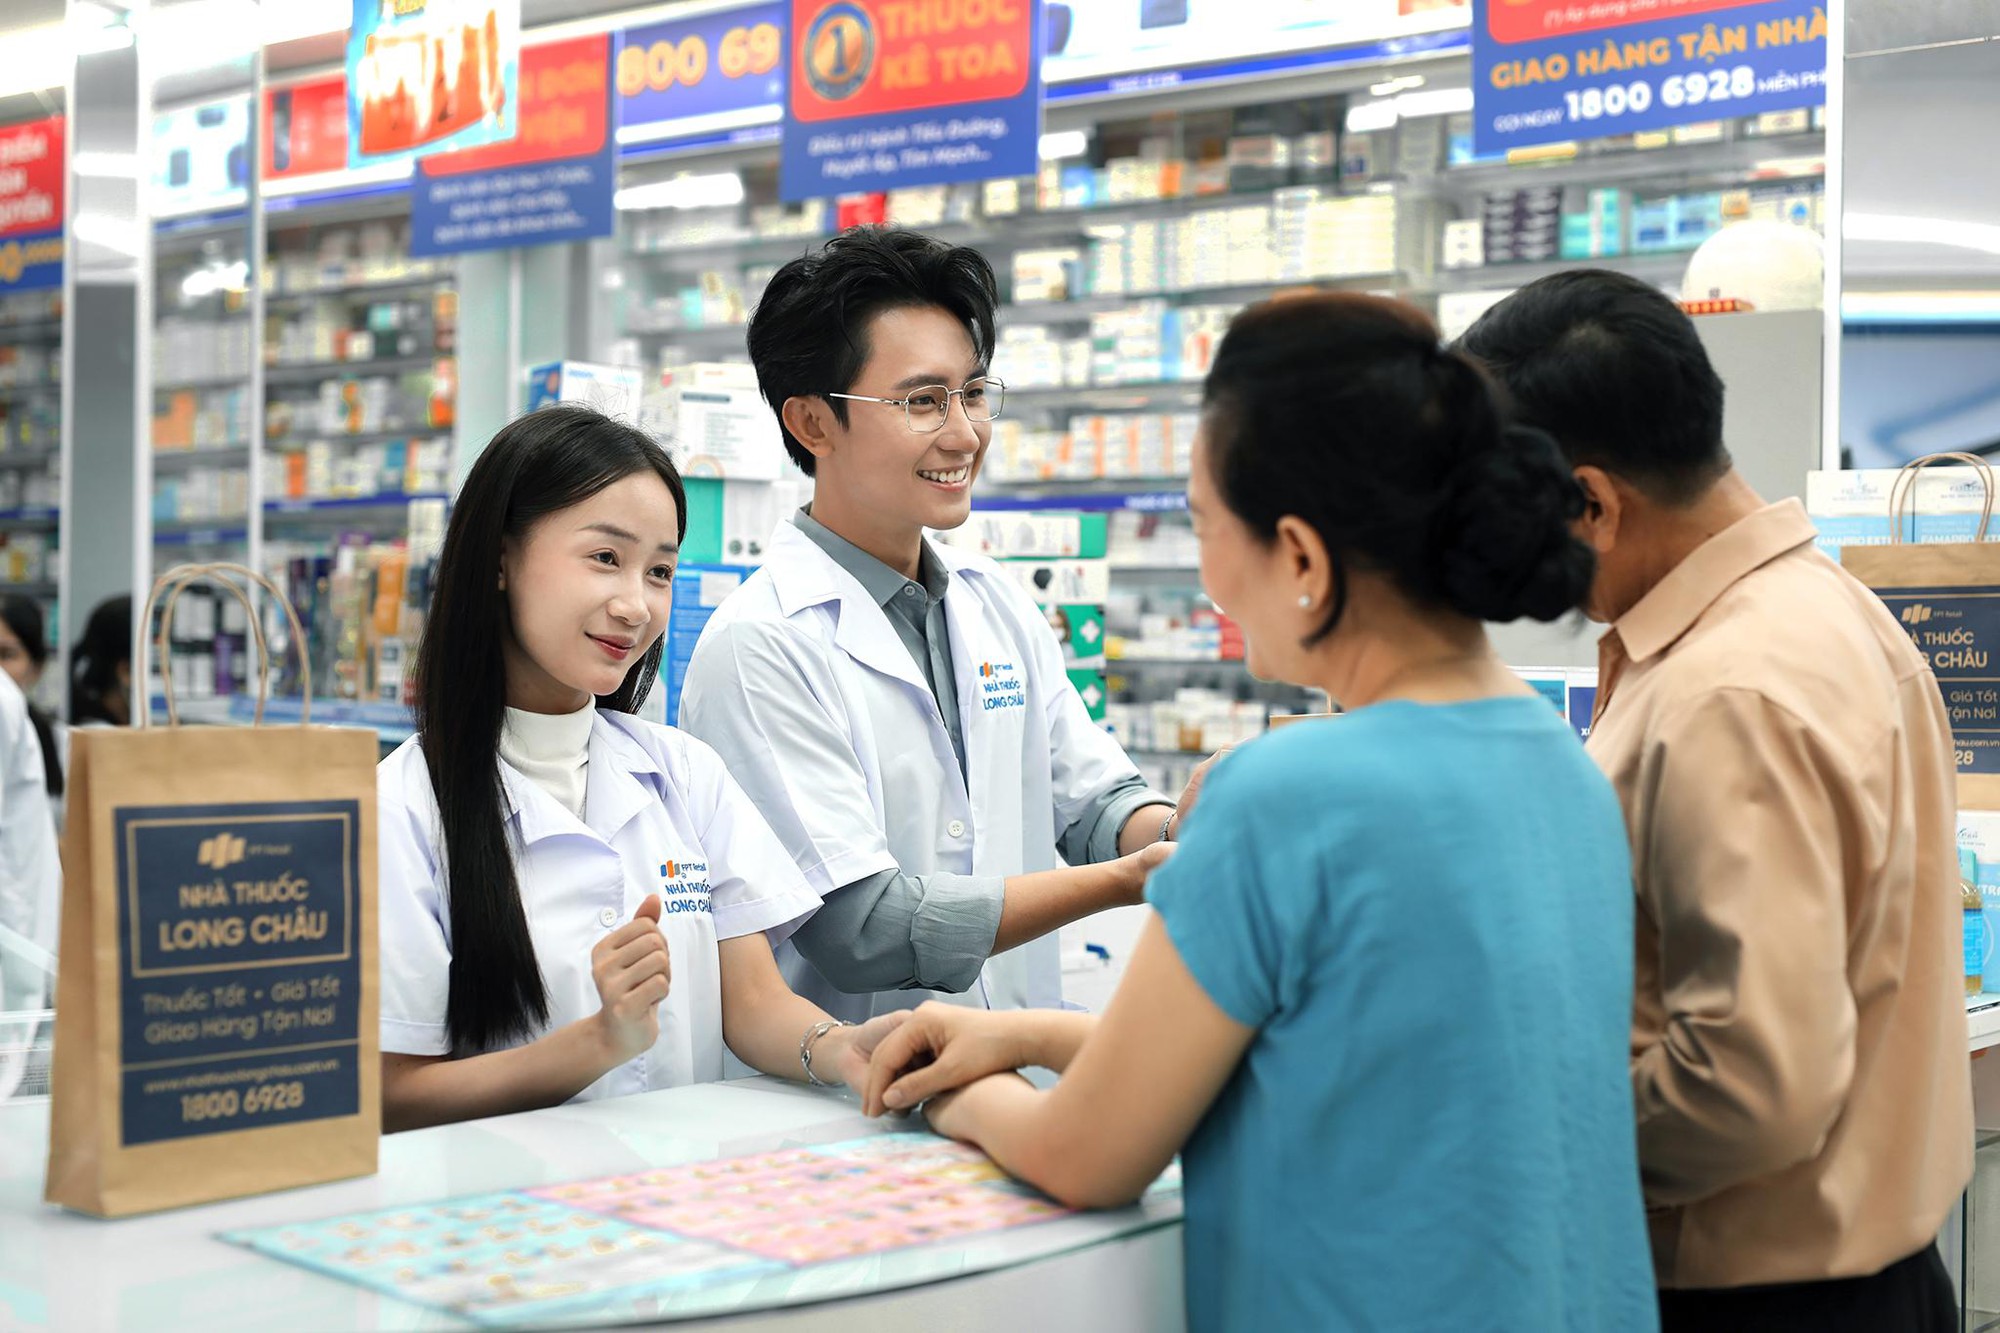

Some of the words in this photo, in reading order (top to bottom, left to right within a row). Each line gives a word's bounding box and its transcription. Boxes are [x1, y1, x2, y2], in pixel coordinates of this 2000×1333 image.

[616, 33, 708, 97] 800
[718, 22, 782, 79] 69
[936, 39, 1018, 82] TOA
[1490, 54, 1569, 89] GIAO
[1577, 38, 1671, 76] HÀNG
[1677, 23, 1748, 63] TẬN
[1756, 7, 1826, 49] NHÀ
[1564, 81, 1652, 122] 1800
[1660, 64, 1756, 107] 6928
[1923, 626, 1975, 646] THUỐC
[1934, 646, 1989, 669] CHÂU
[983, 679, 1000, 693] NHÀ
[999, 676, 1021, 691] THUỐC
[1950, 689, 1973, 703] Giá
[1975, 687, 1998, 703] Tốt
[982, 696, 1008, 711] LONG
[1946, 706, 1971, 722] Tận
[1973, 706, 1997, 720] Nơi
[1954, 749, 1975, 766] 28
[179, 878, 230, 908] NHÀ
[232, 871, 310, 905] THUỐC
[665, 880, 688, 896] NHÀ
[664, 899, 698, 915] LONG
[159, 917, 246, 951] LONG
[250, 904, 329, 946] CHÂU
[143, 987, 208, 1014] Thuốc
[211, 983, 247, 1007] Tốt
[270, 980, 308, 1002] Giá
[309, 974, 341, 998] Tốt
[144, 1020, 200, 1045] Giao
[201, 1014, 259, 1040] Hàng
[261, 1009, 300, 1035] Tận
[302, 1004, 337, 1027] Nơi
[180, 1089, 240, 1123] 1800
[242, 1081, 305, 1114] 6928
